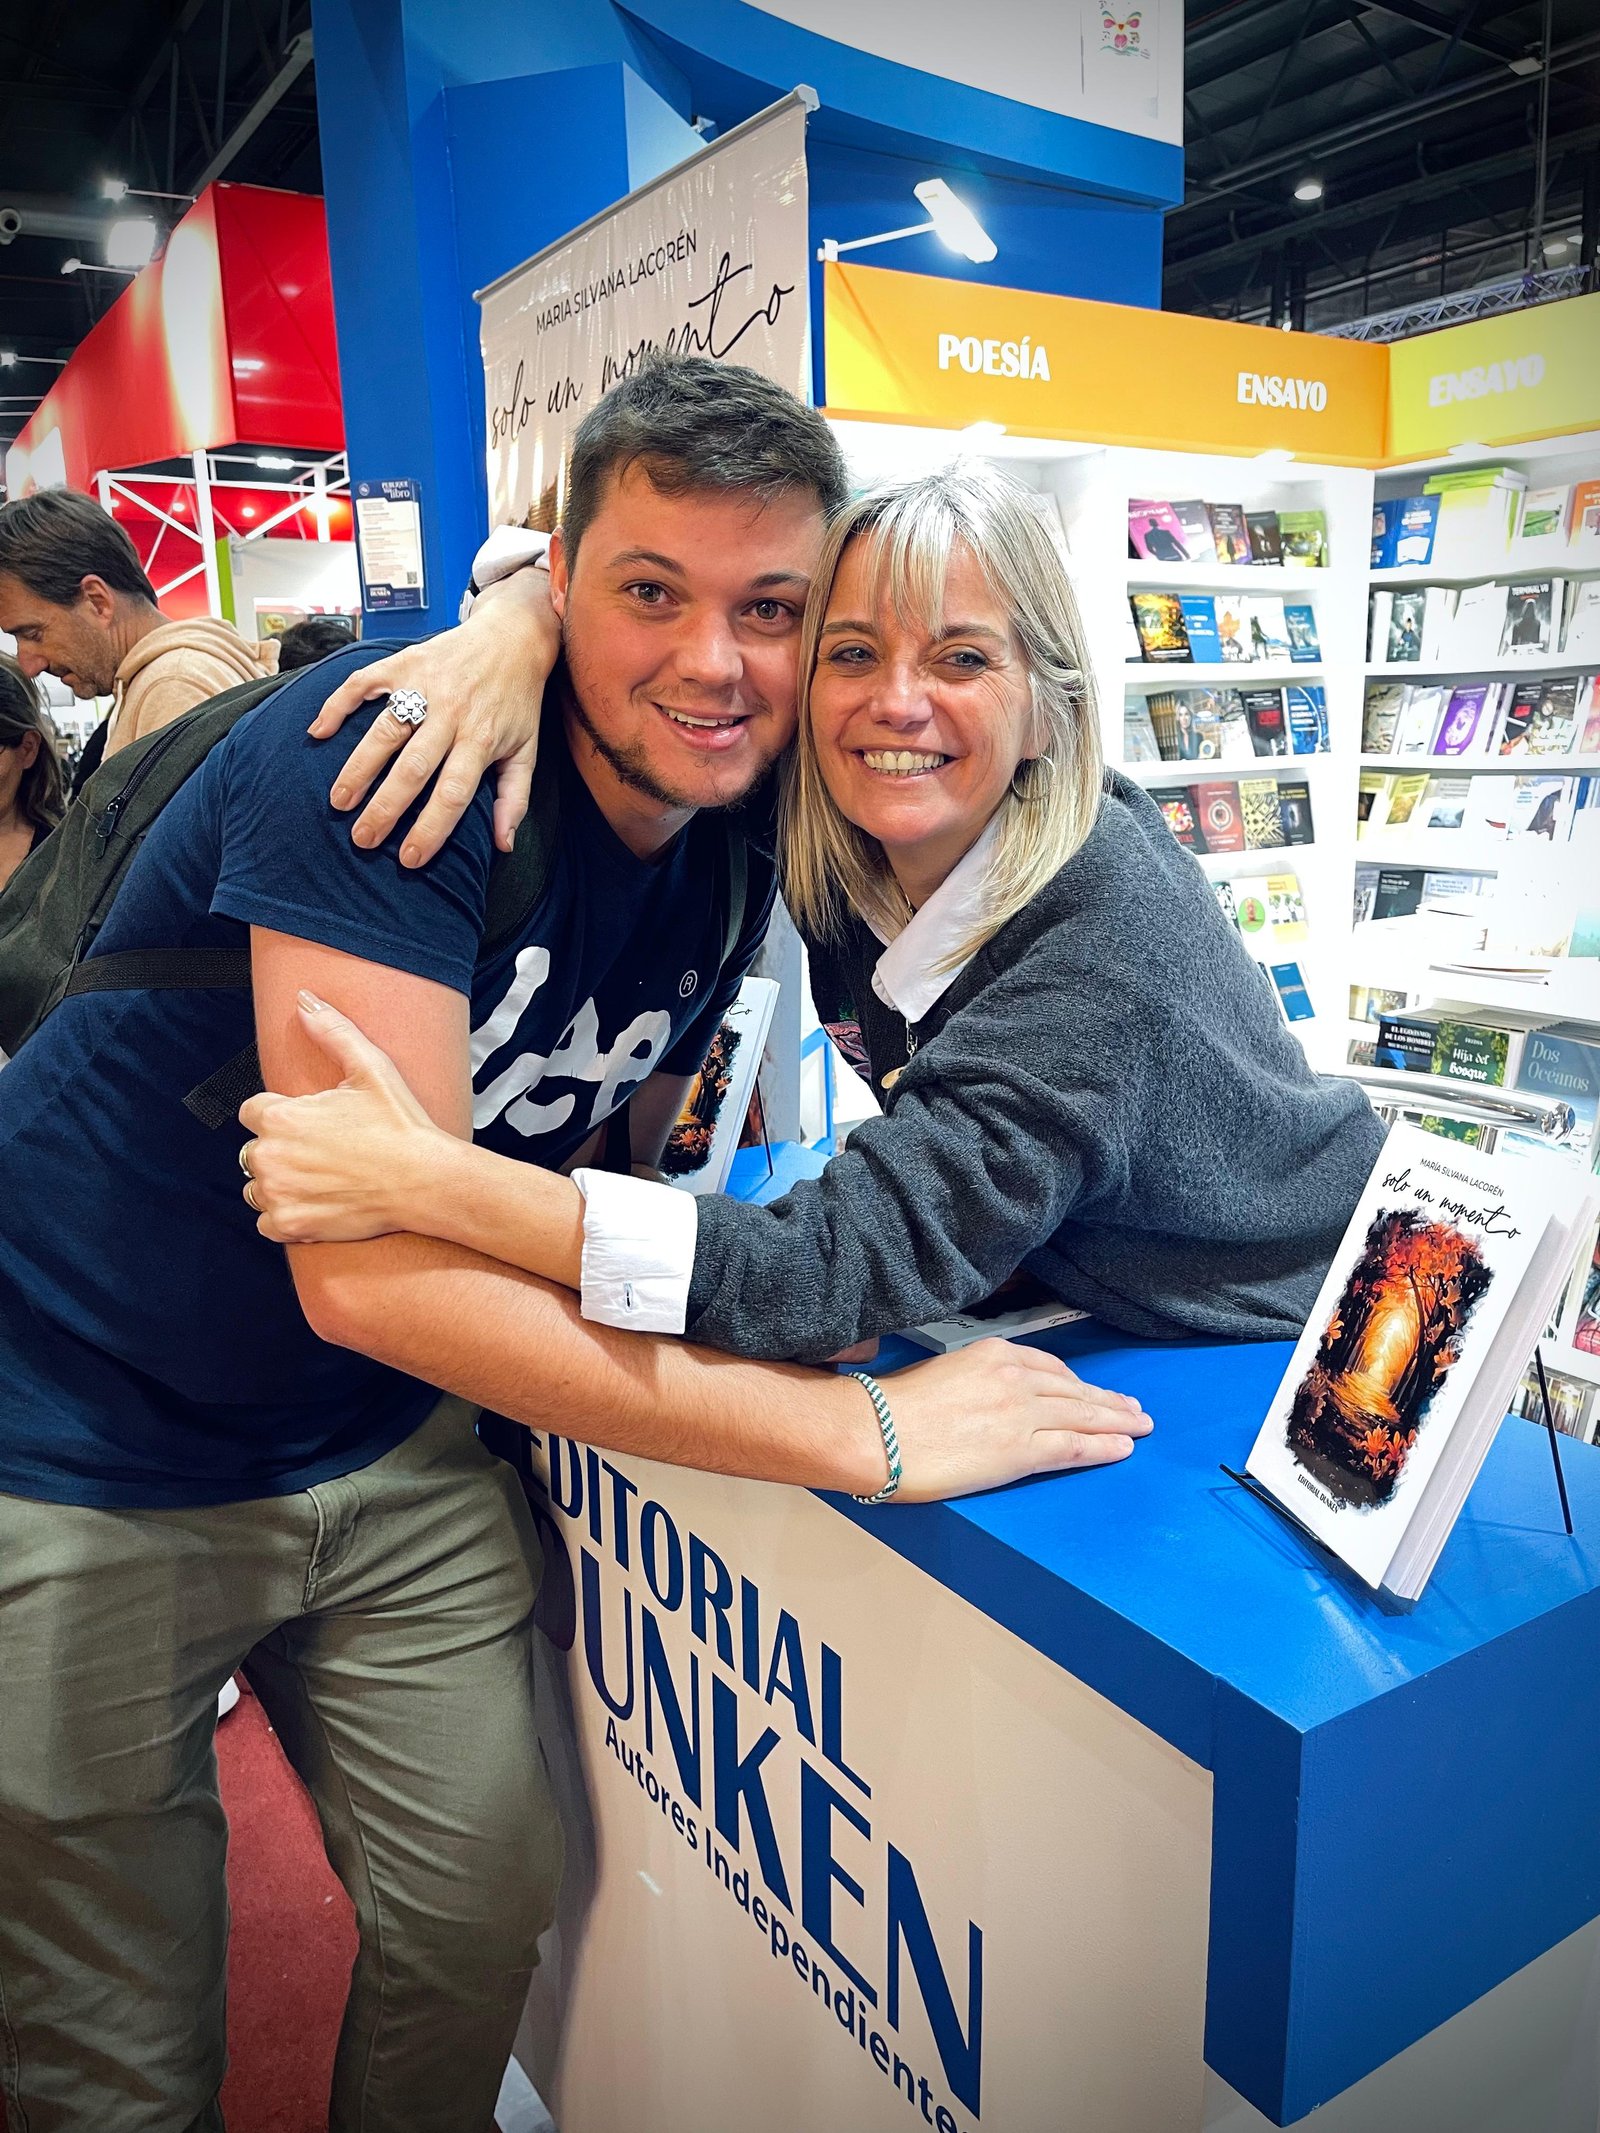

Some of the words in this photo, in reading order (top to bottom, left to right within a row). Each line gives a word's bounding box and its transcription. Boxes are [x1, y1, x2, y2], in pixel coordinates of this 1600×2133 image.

[574, 268, 625, 316] SILVANA
[627, 228, 698, 286] LACORÉN
[938, 333, 1051, 382] POESÍA
[1429, 354, 1545, 408] ENSAYO
[491, 359, 536, 449] solo
[546, 376, 584, 414] un
[1237, 372, 1328, 413] ENSAYO
[1448, 1062, 1488, 1081] bosque
[1531, 1040, 1561, 1064] Dos
[1527, 1062, 1591, 1093] Océanos
[1420, 1158, 1441, 1173] MARÍA
[1441, 1166, 1469, 1184] SILVANA
[1469, 1177, 1505, 1198] LACORÉN
[1381, 1168, 1411, 1193] solo
[1414, 1187, 1435, 1203] un
[1439, 1196, 1522, 1240] momento
[1297, 1473, 1321, 1498] EDITORIAL
[1319, 1493, 1339, 1514] DUNKEN
[521, 1425, 873, 1799] EDITORIAL
[604, 1714, 700, 1850] Autores
[706, 1826, 966, 2133] Independiente
